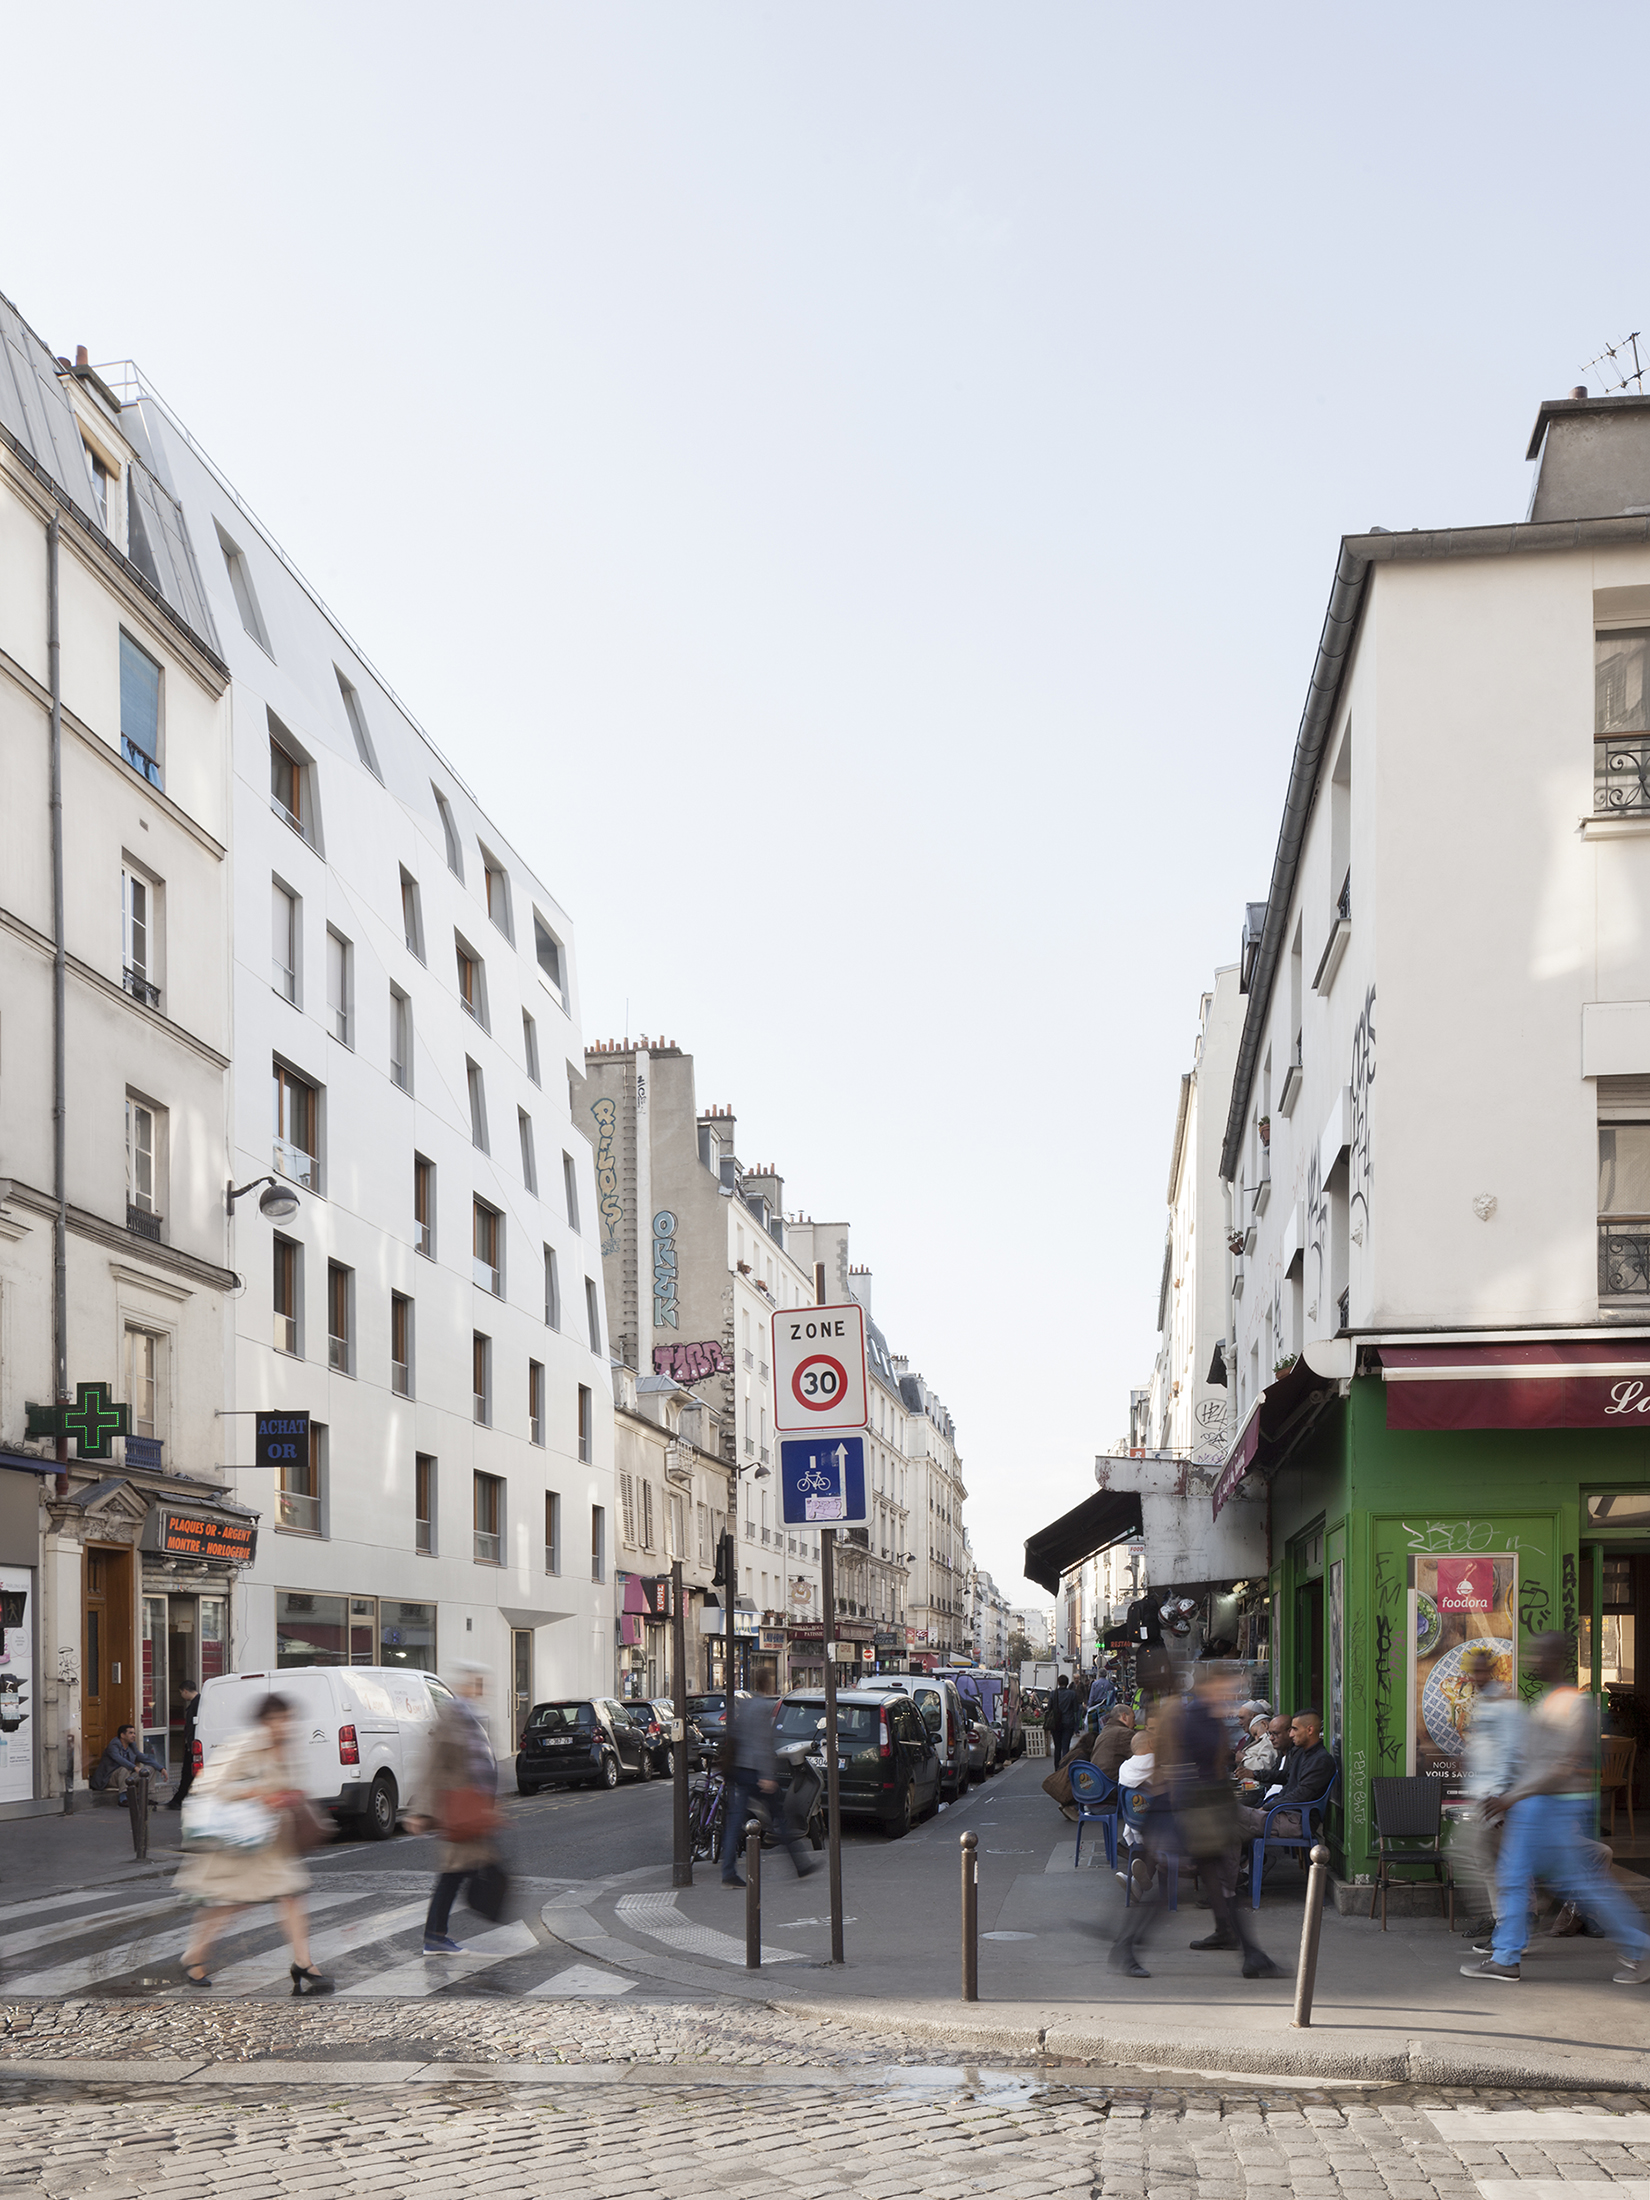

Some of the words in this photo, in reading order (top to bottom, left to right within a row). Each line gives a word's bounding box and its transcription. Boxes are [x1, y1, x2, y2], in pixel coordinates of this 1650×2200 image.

[790, 1320, 845, 1340] ZONE
[803, 1370, 837, 1396] 30
[257, 1419, 307, 1436] ACHAT
[267, 1443, 298, 1459] OR
[169, 1517, 205, 1535] PLAQUES
[205, 1523, 218, 1537] OR
[222, 1526, 252, 1542] ARGENT
[167, 1536, 201, 1553] MONTRE
[206, 1542, 251, 1560] HORLOGERIE
[1442, 1596, 1488, 1609] foodora
[1432, 1761, 1457, 1769] NOUS
[1425, 1770, 1450, 1778] VOUS
